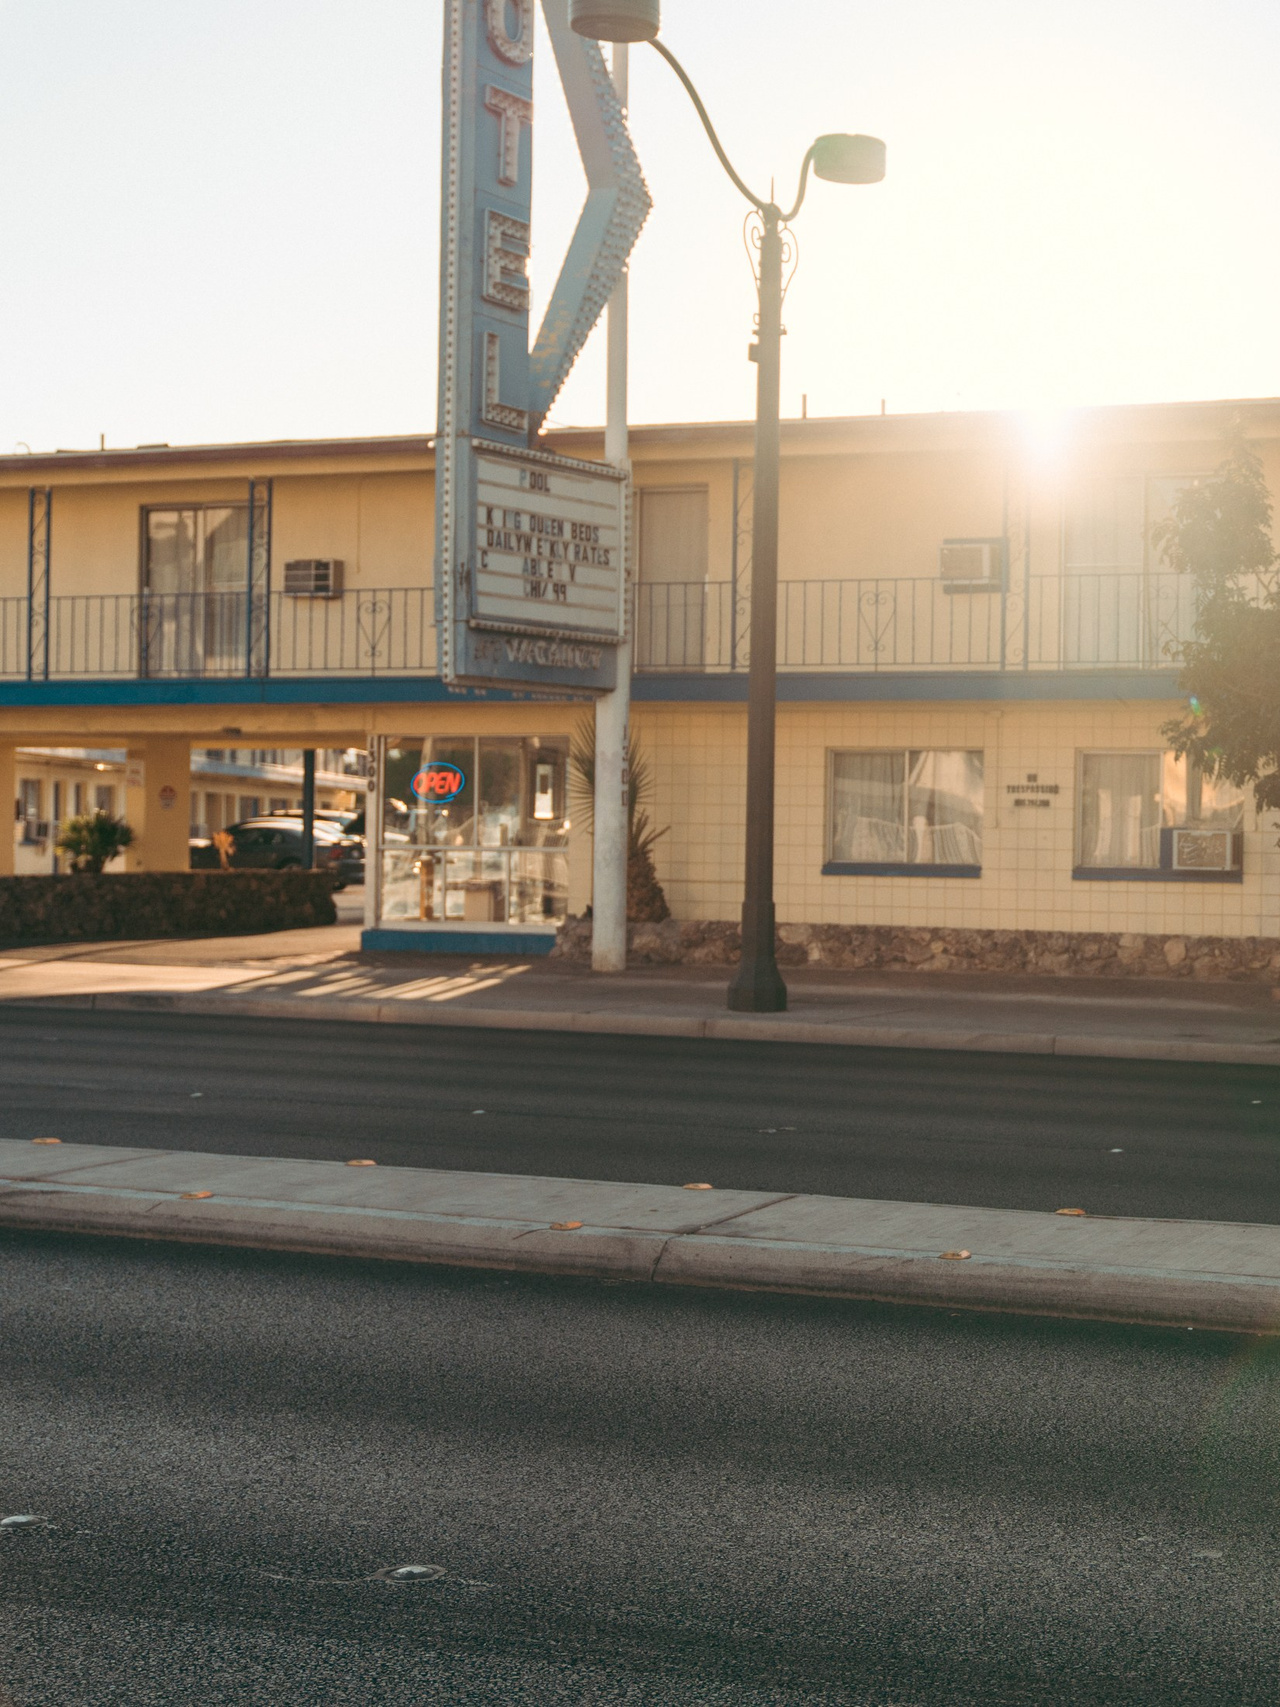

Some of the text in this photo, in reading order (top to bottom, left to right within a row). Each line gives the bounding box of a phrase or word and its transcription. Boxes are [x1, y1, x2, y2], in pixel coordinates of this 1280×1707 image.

[519, 468, 550, 492] POOL
[571, 522, 599, 543] BEDS
[413, 771, 461, 794] OPEN
